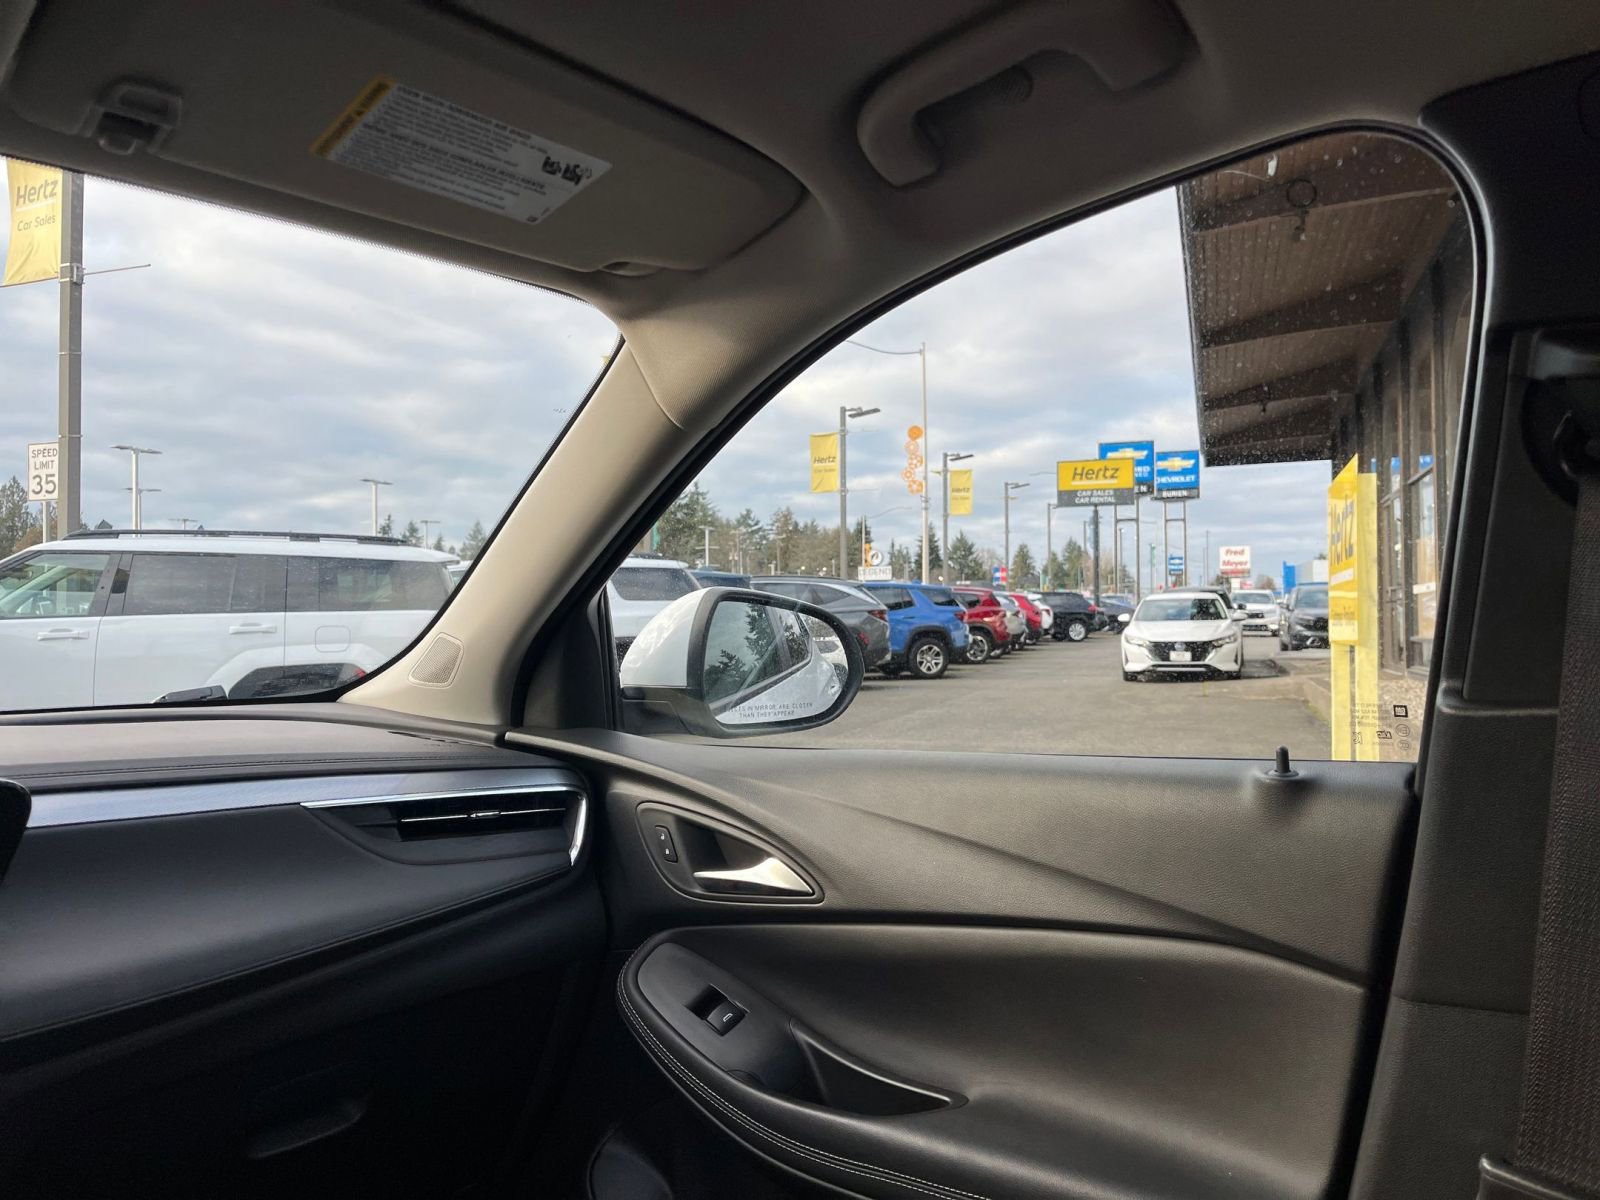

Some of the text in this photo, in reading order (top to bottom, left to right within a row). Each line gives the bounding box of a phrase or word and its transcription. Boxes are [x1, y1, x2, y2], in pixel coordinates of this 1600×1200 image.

[16, 179, 58, 207] Hertz
[17, 214, 56, 232] Car Sales
[31, 447, 58, 458] SPEED
[34, 460, 55, 470] LIMIT
[813, 456, 837, 464] Hertz
[1072, 466, 1120, 481] Hertz
[31, 474, 57, 495] 35
[1162, 490, 1188, 498] BURIEN
[1075, 496, 1090, 504] CAR
[1225, 548, 1245, 556] Fred
[1222, 560, 1248, 568] Meyer
